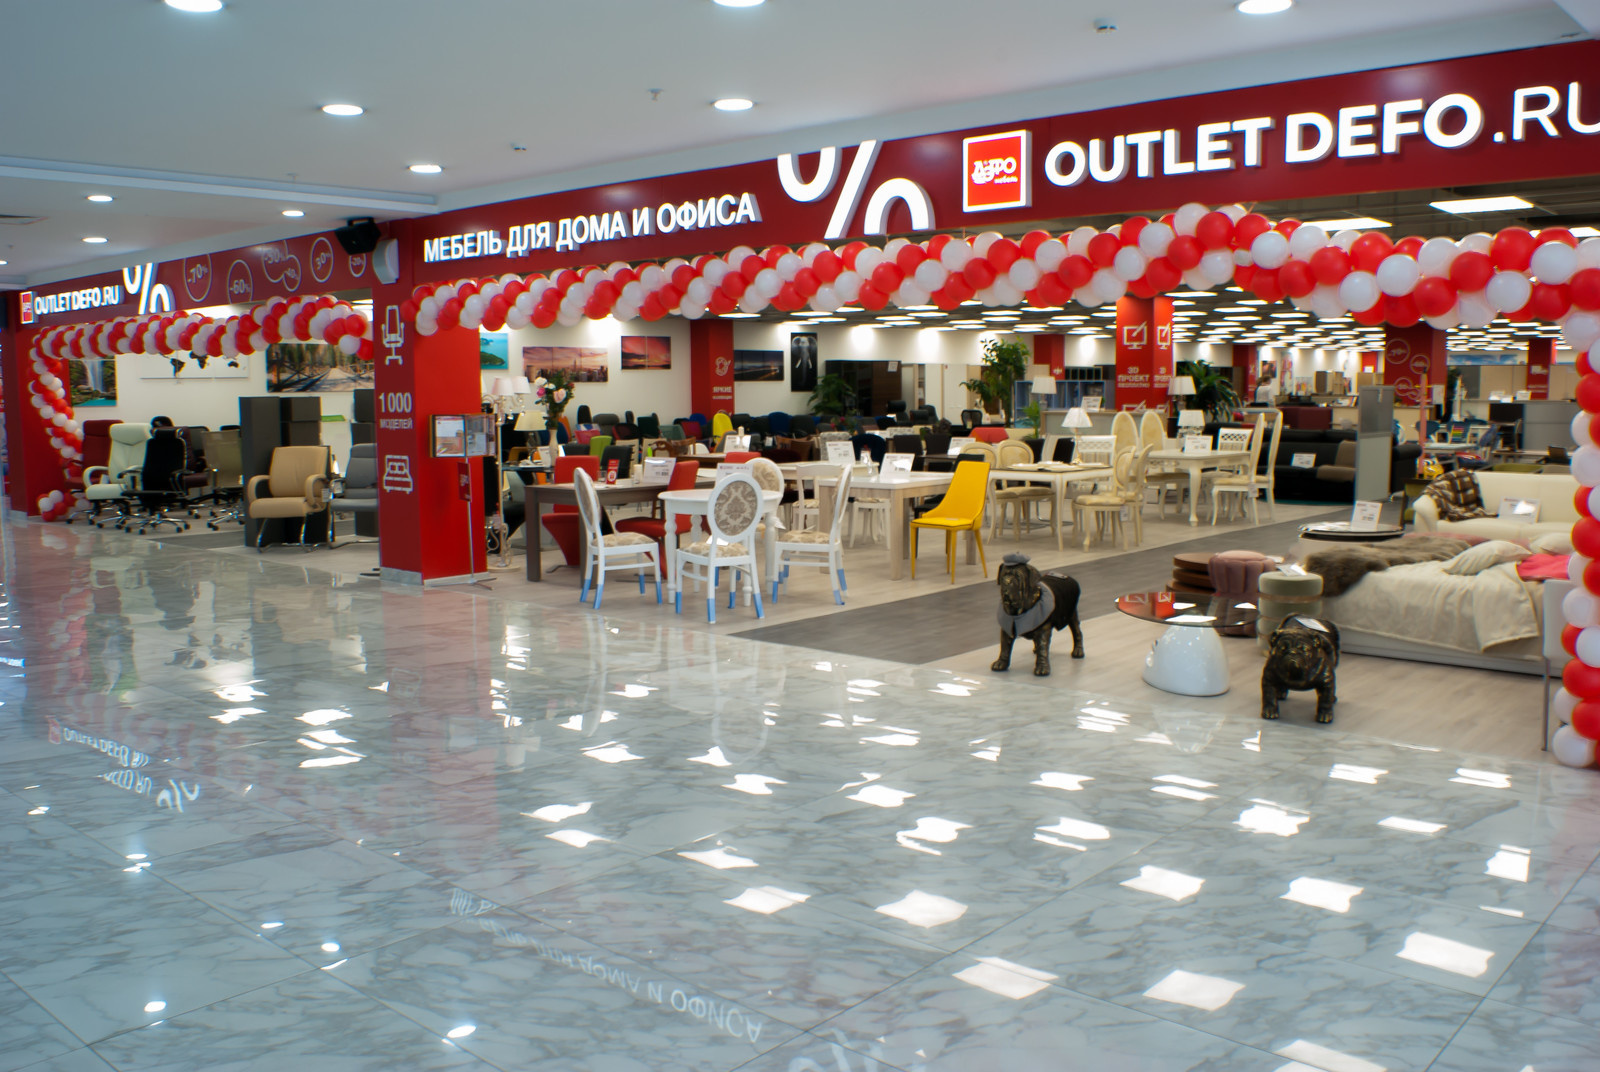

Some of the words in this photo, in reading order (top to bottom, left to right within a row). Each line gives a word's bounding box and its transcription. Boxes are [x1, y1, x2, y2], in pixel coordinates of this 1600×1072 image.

[1044, 116, 1273, 187] OUTLET
[424, 230, 503, 263] МЕБЕЛЬ
[506, 222, 551, 257] ДЛЯ
[556, 211, 627, 252] ДОМА
[632, 207, 649, 236] И
[656, 192, 757, 233] ОФИСА
[34, 292, 71, 315] OUTLET
[380, 418, 413, 430] МОДЕЛЕЙ
